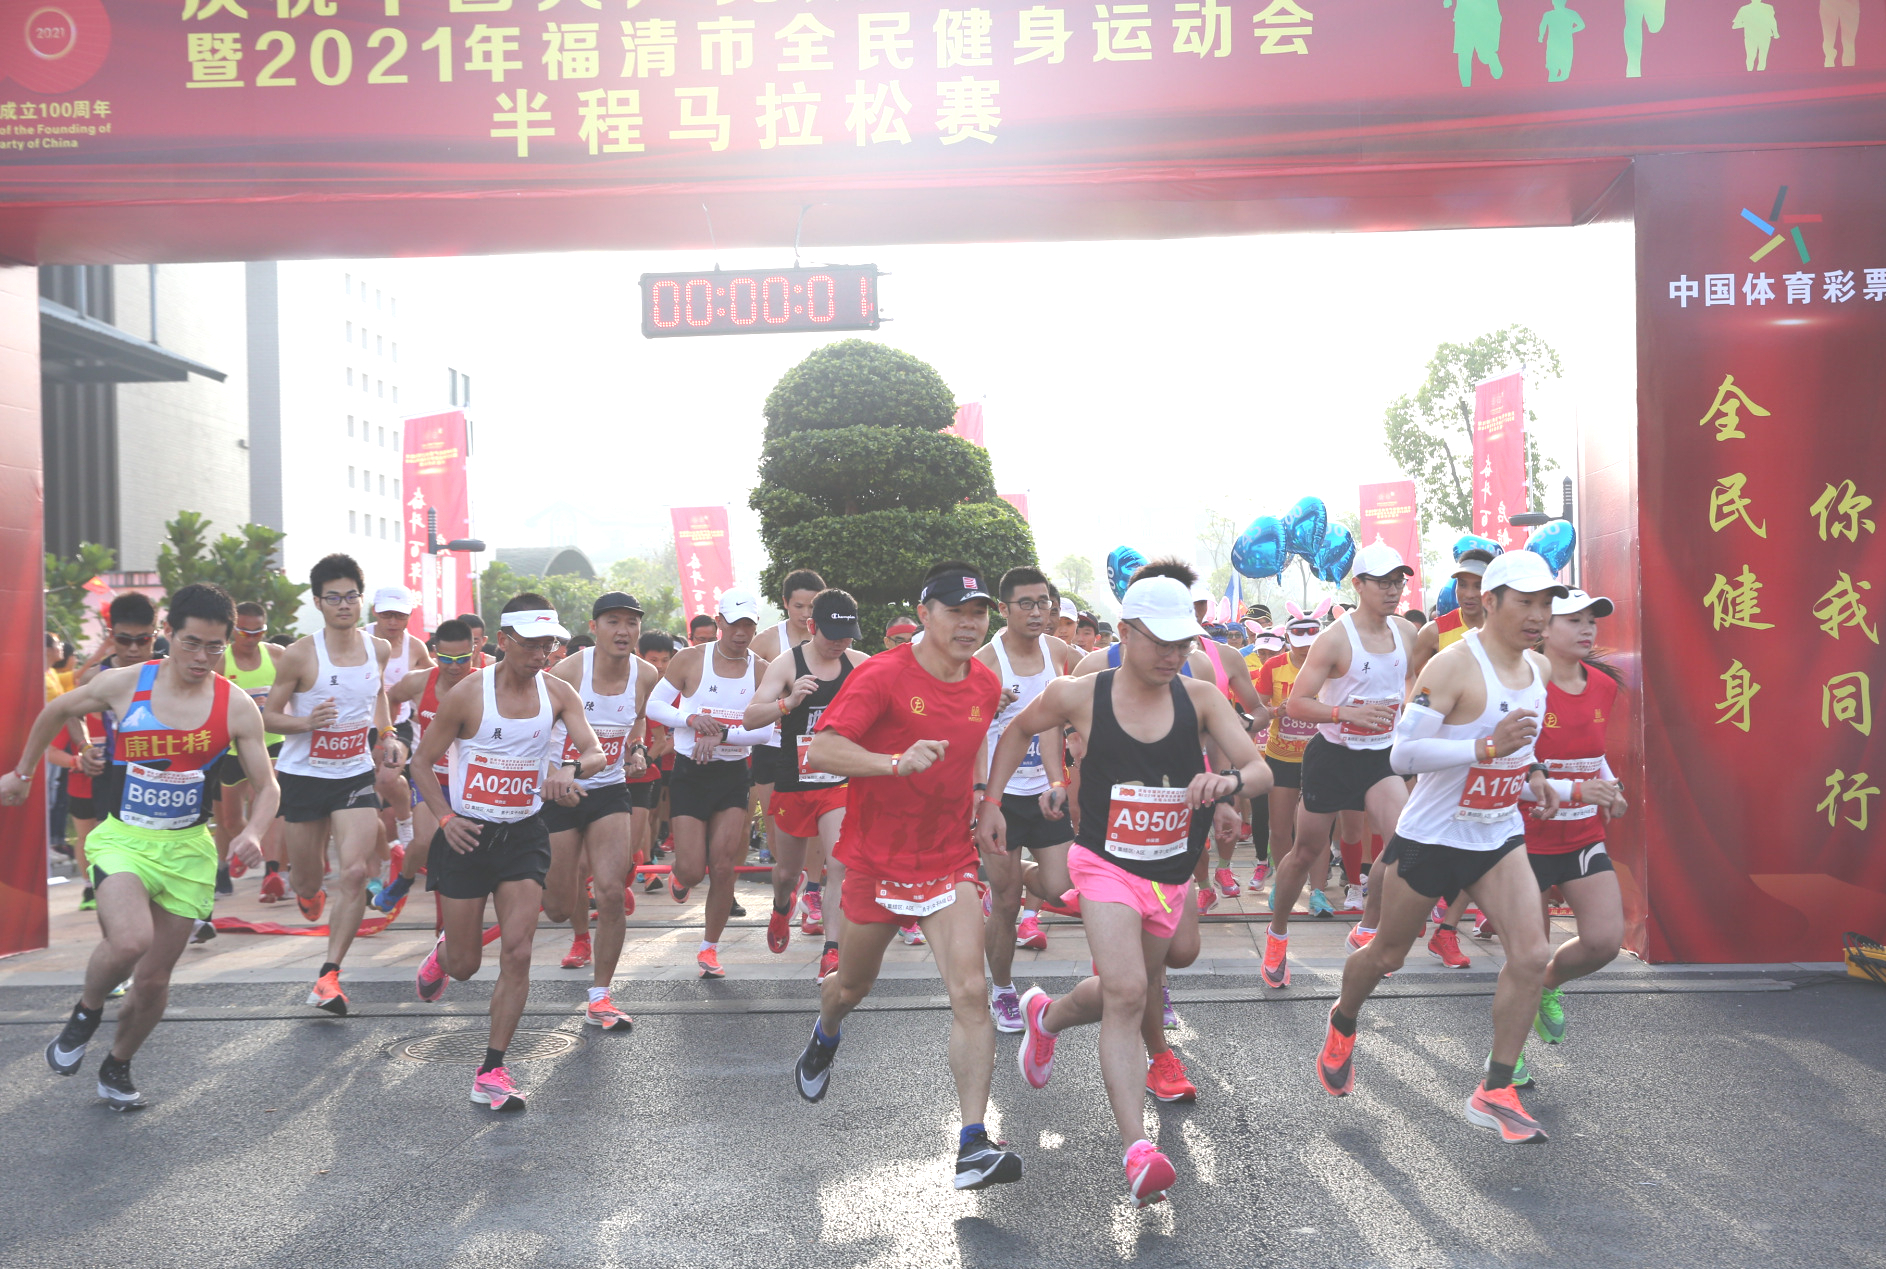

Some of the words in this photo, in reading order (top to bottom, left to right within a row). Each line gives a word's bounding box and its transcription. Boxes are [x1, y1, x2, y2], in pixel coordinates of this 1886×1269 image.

[35, 27, 66, 39] 2021
[186, 0, 1314, 88] 暨2021年福清市全民健身运动会
[0, 100, 112, 120] 成立100周年
[490, 76, 1002, 158] 半程马拉松赛
[14, 125, 35, 135] the
[37, 123, 97, 136] Founding
[99, 122, 112, 133] of
[27, 137, 40, 148] of
[42, 137, 79, 148] China
[1669, 268, 1886, 308] 中国体育彩票
[1700, 373, 1776, 733] 全民健身
[1810, 479, 1881, 831] 你我同行
[125, 729, 212, 757] 康比特
[314, 733, 365, 750] A6672
[128, 783, 198, 808] B6896
[468, 772, 534, 795] A0206
[1113, 808, 1190, 832] A9502
